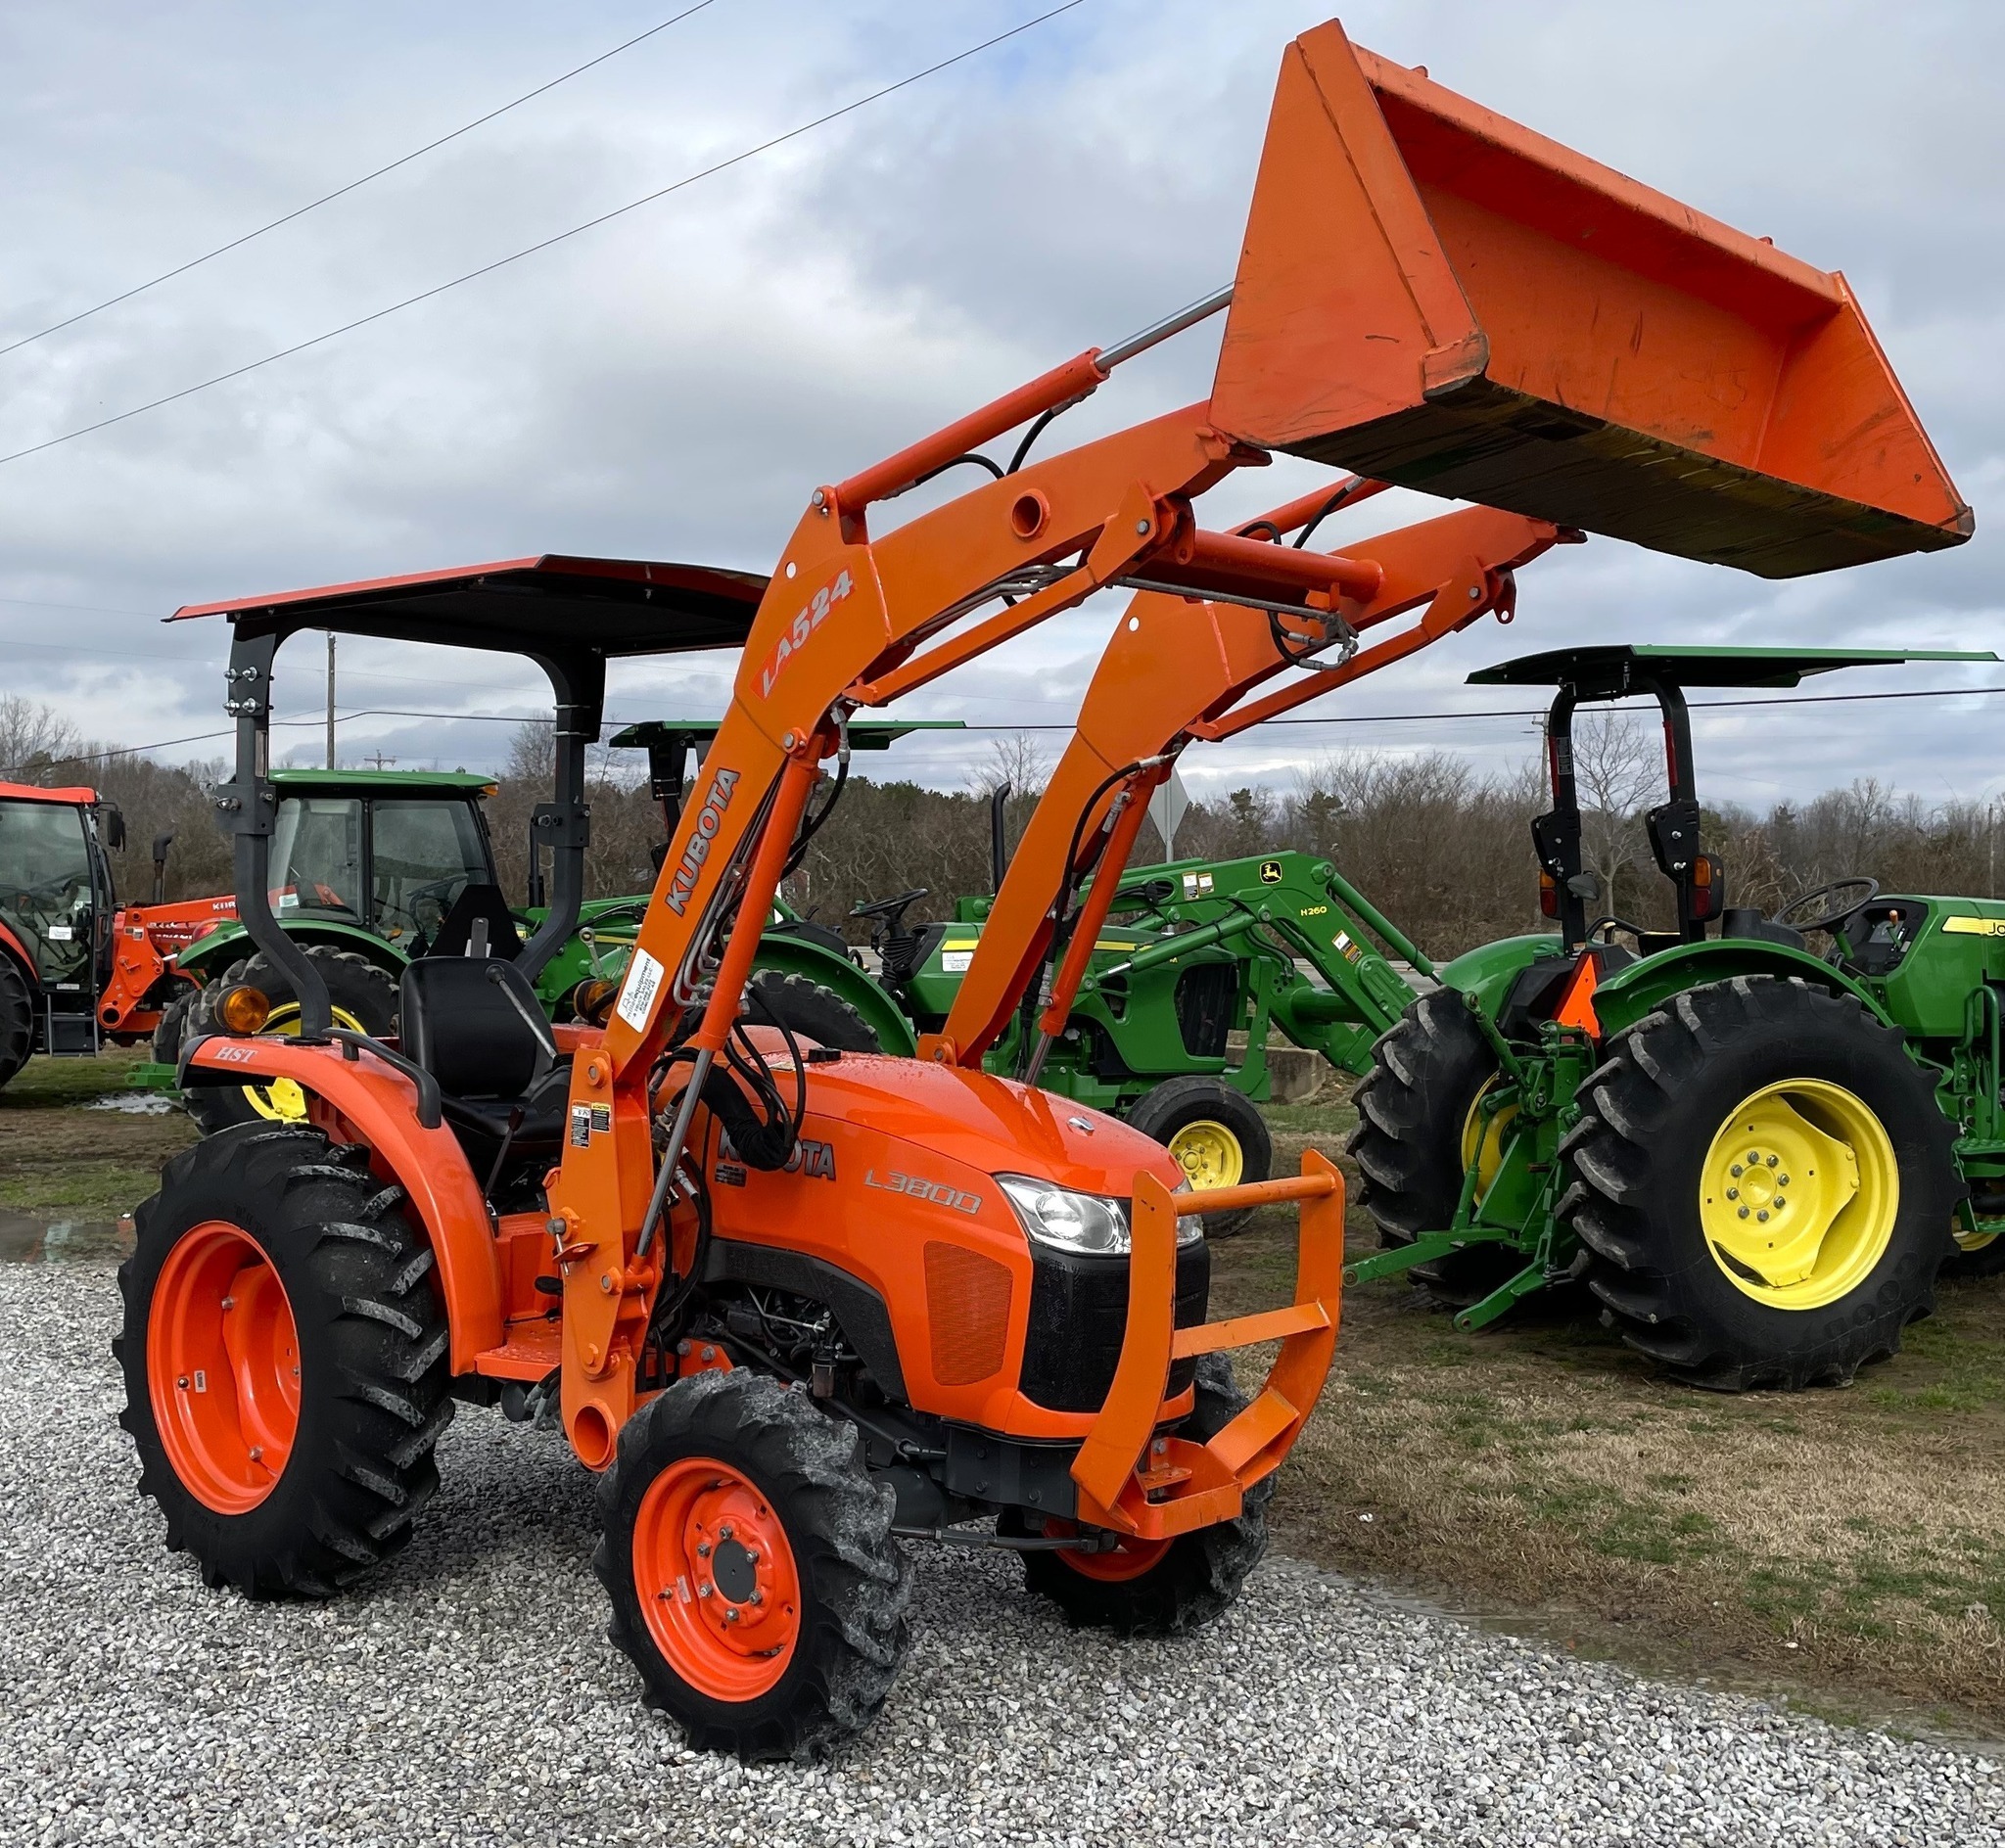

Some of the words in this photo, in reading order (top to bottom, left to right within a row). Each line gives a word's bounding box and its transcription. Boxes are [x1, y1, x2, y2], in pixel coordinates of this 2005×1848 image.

[762, 569, 854, 699] LA524
[664, 767, 741, 917] KUBOTA
[1300, 905, 1328, 916] H260
[214, 1046, 258, 1063] HST
[718, 1126, 836, 1181] KOTA
[863, 1169, 982, 1215] L3800
